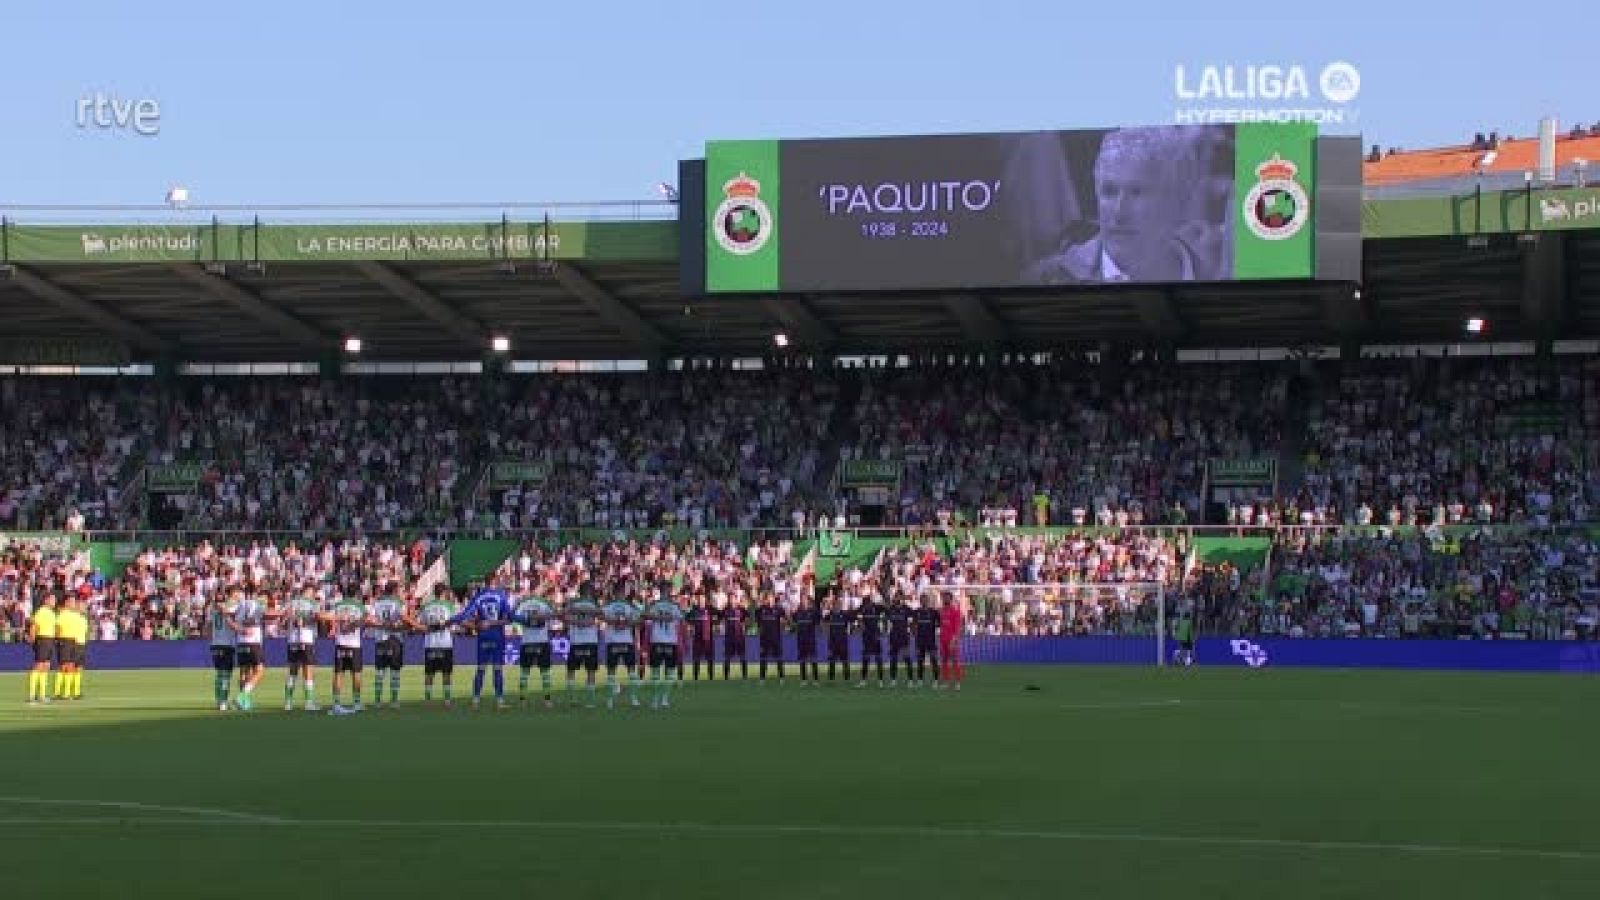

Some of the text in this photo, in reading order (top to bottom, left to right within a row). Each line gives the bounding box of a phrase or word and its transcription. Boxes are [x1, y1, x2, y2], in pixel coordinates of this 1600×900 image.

[861, 222, 896, 237] 1938
[911, 221, 949, 236] 2024
[297, 238, 320, 253] LA
[415, 236, 467, 251] PARA
[471, 233, 561, 251] CAMBIAR
